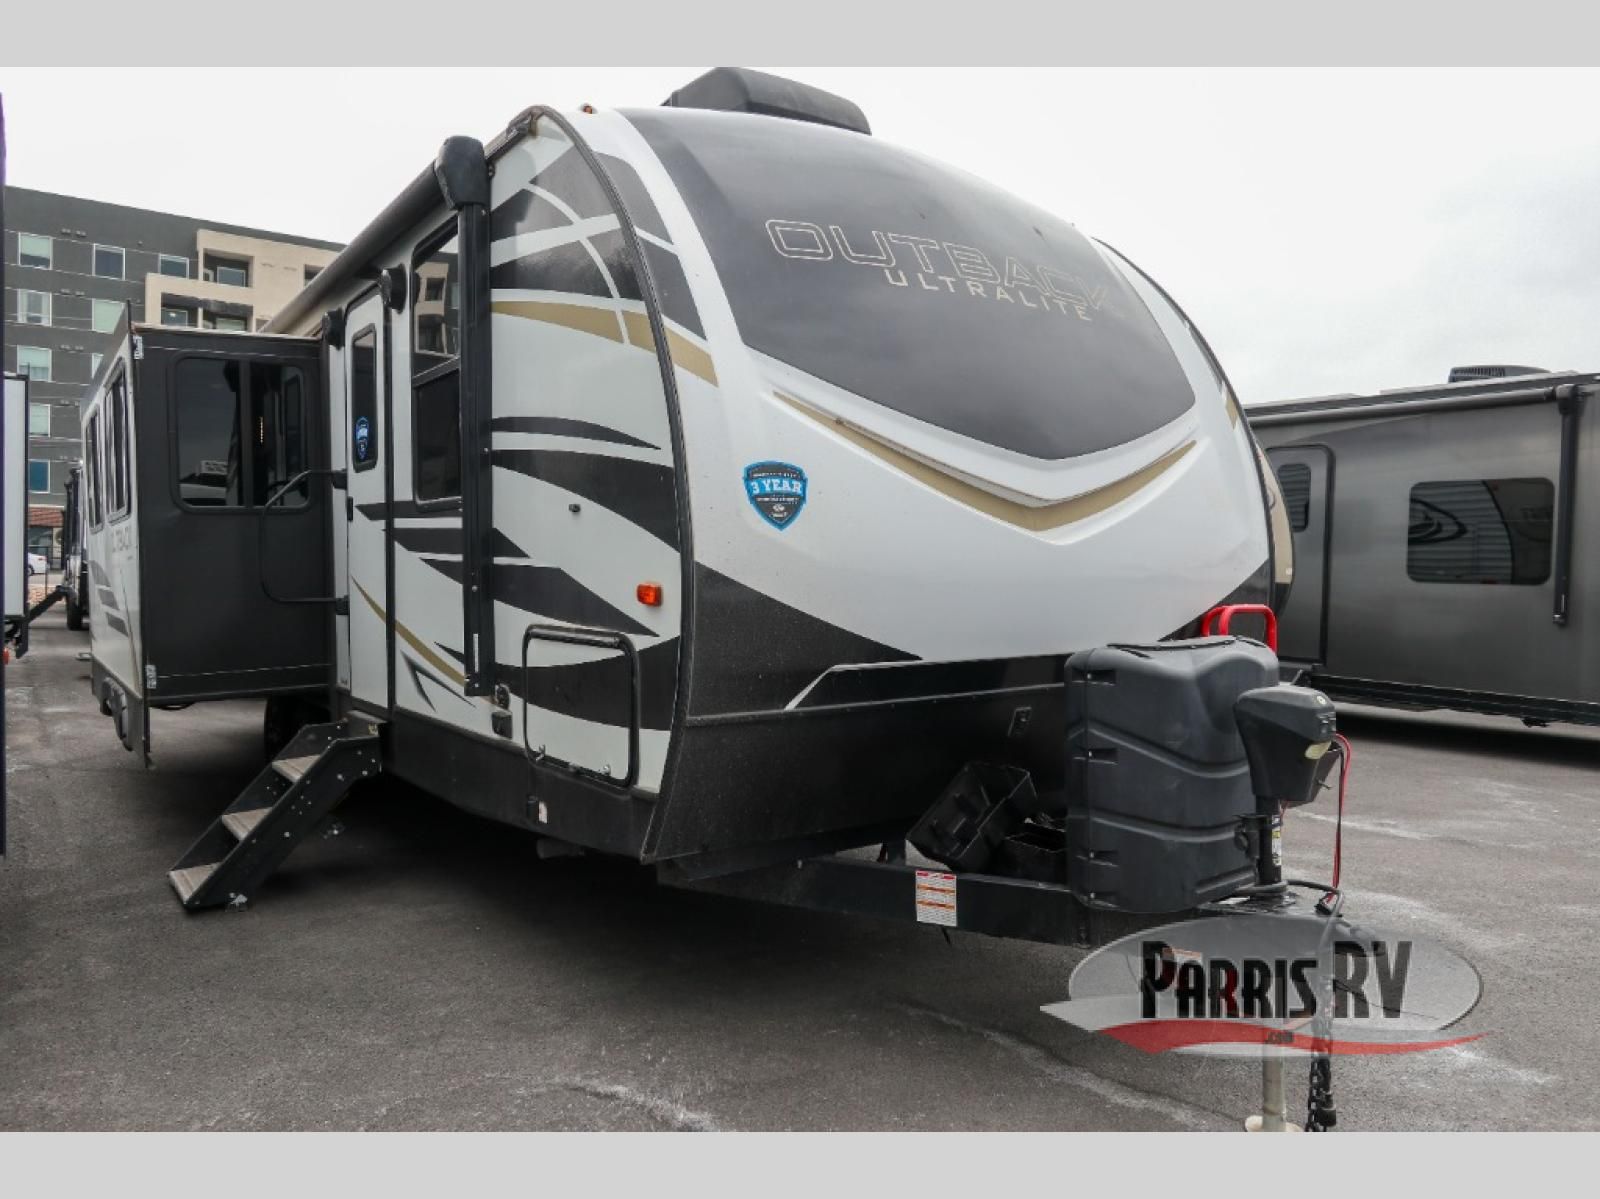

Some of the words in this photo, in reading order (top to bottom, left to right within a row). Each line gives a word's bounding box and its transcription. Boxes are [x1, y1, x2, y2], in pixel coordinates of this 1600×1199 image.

[884, 268, 1092, 321] ULTRALITE
[751, 481, 760, 494] 3
[763, 478, 802, 495] YEAR
